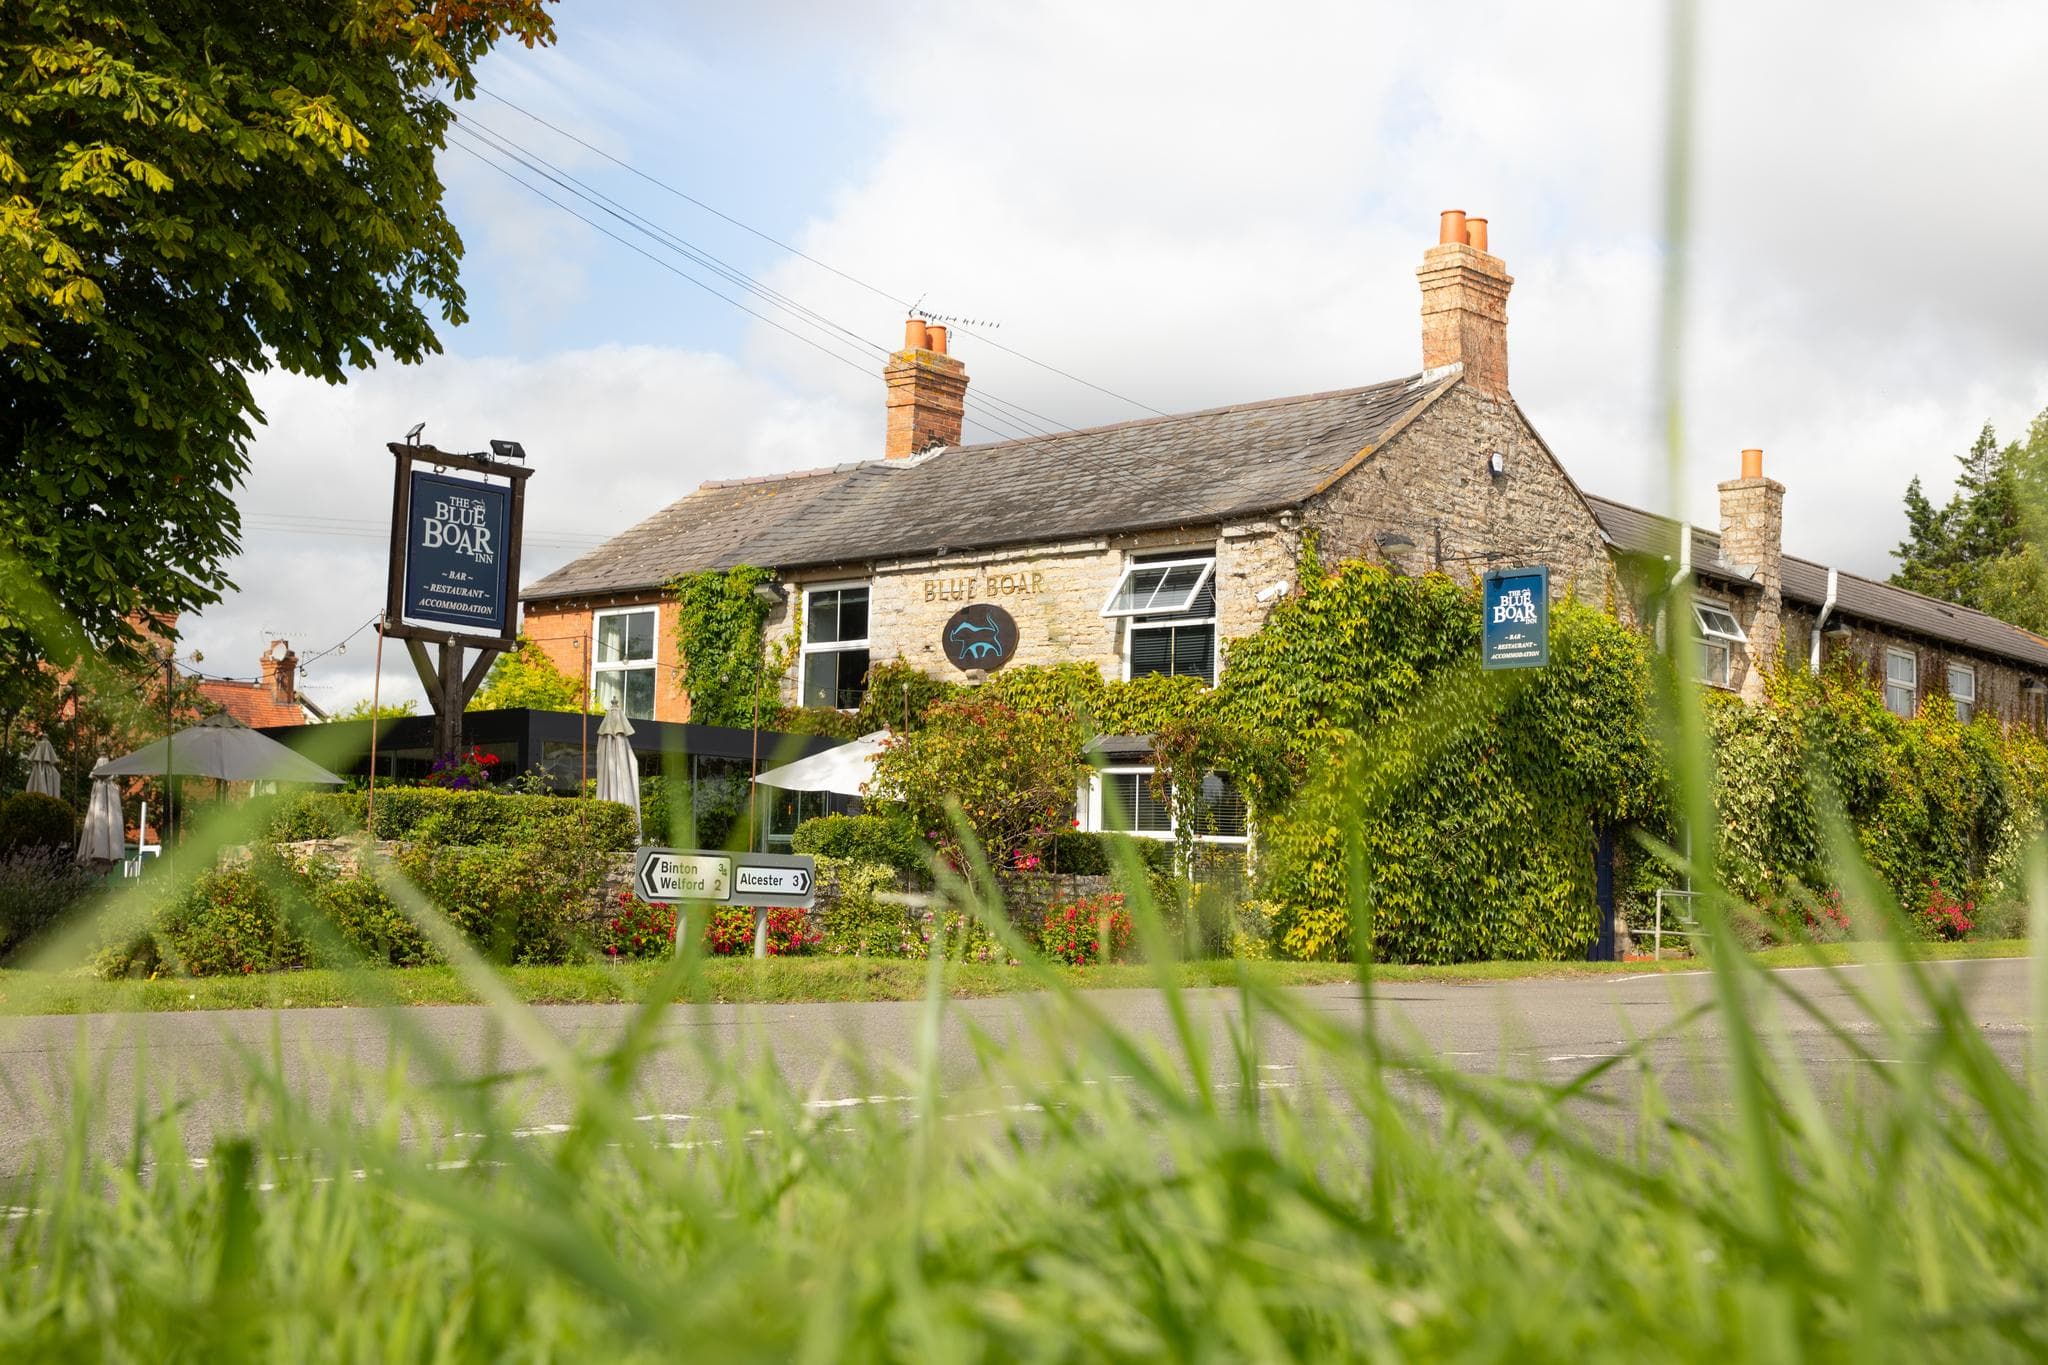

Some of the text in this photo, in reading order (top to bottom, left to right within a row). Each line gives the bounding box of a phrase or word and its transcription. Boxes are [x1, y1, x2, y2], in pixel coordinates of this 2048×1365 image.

[450, 496, 470, 508] THE
[435, 501, 486, 527] BLUE
[422, 517, 494, 556] BOAR
[475, 553, 493, 564] INN
[449, 571, 467, 580] BAR
[430, 584, 485, 598] RESTAURANT
[924, 572, 1044, 603] BLUE BOAR
[419, 598, 493, 614] ACCOMMODATION
[1500, 592, 1532, 607] BLUE
[1493, 603, 1537, 623] BOAR
[1498, 642, 1533, 650] RESTAURANT
[1491, 651, 1539, 659] ACCOMMODATION
[661, 861, 698, 875] Binton
[660, 877, 722, 891] Welford 2
[740, 873, 799, 887] Alcester 3
